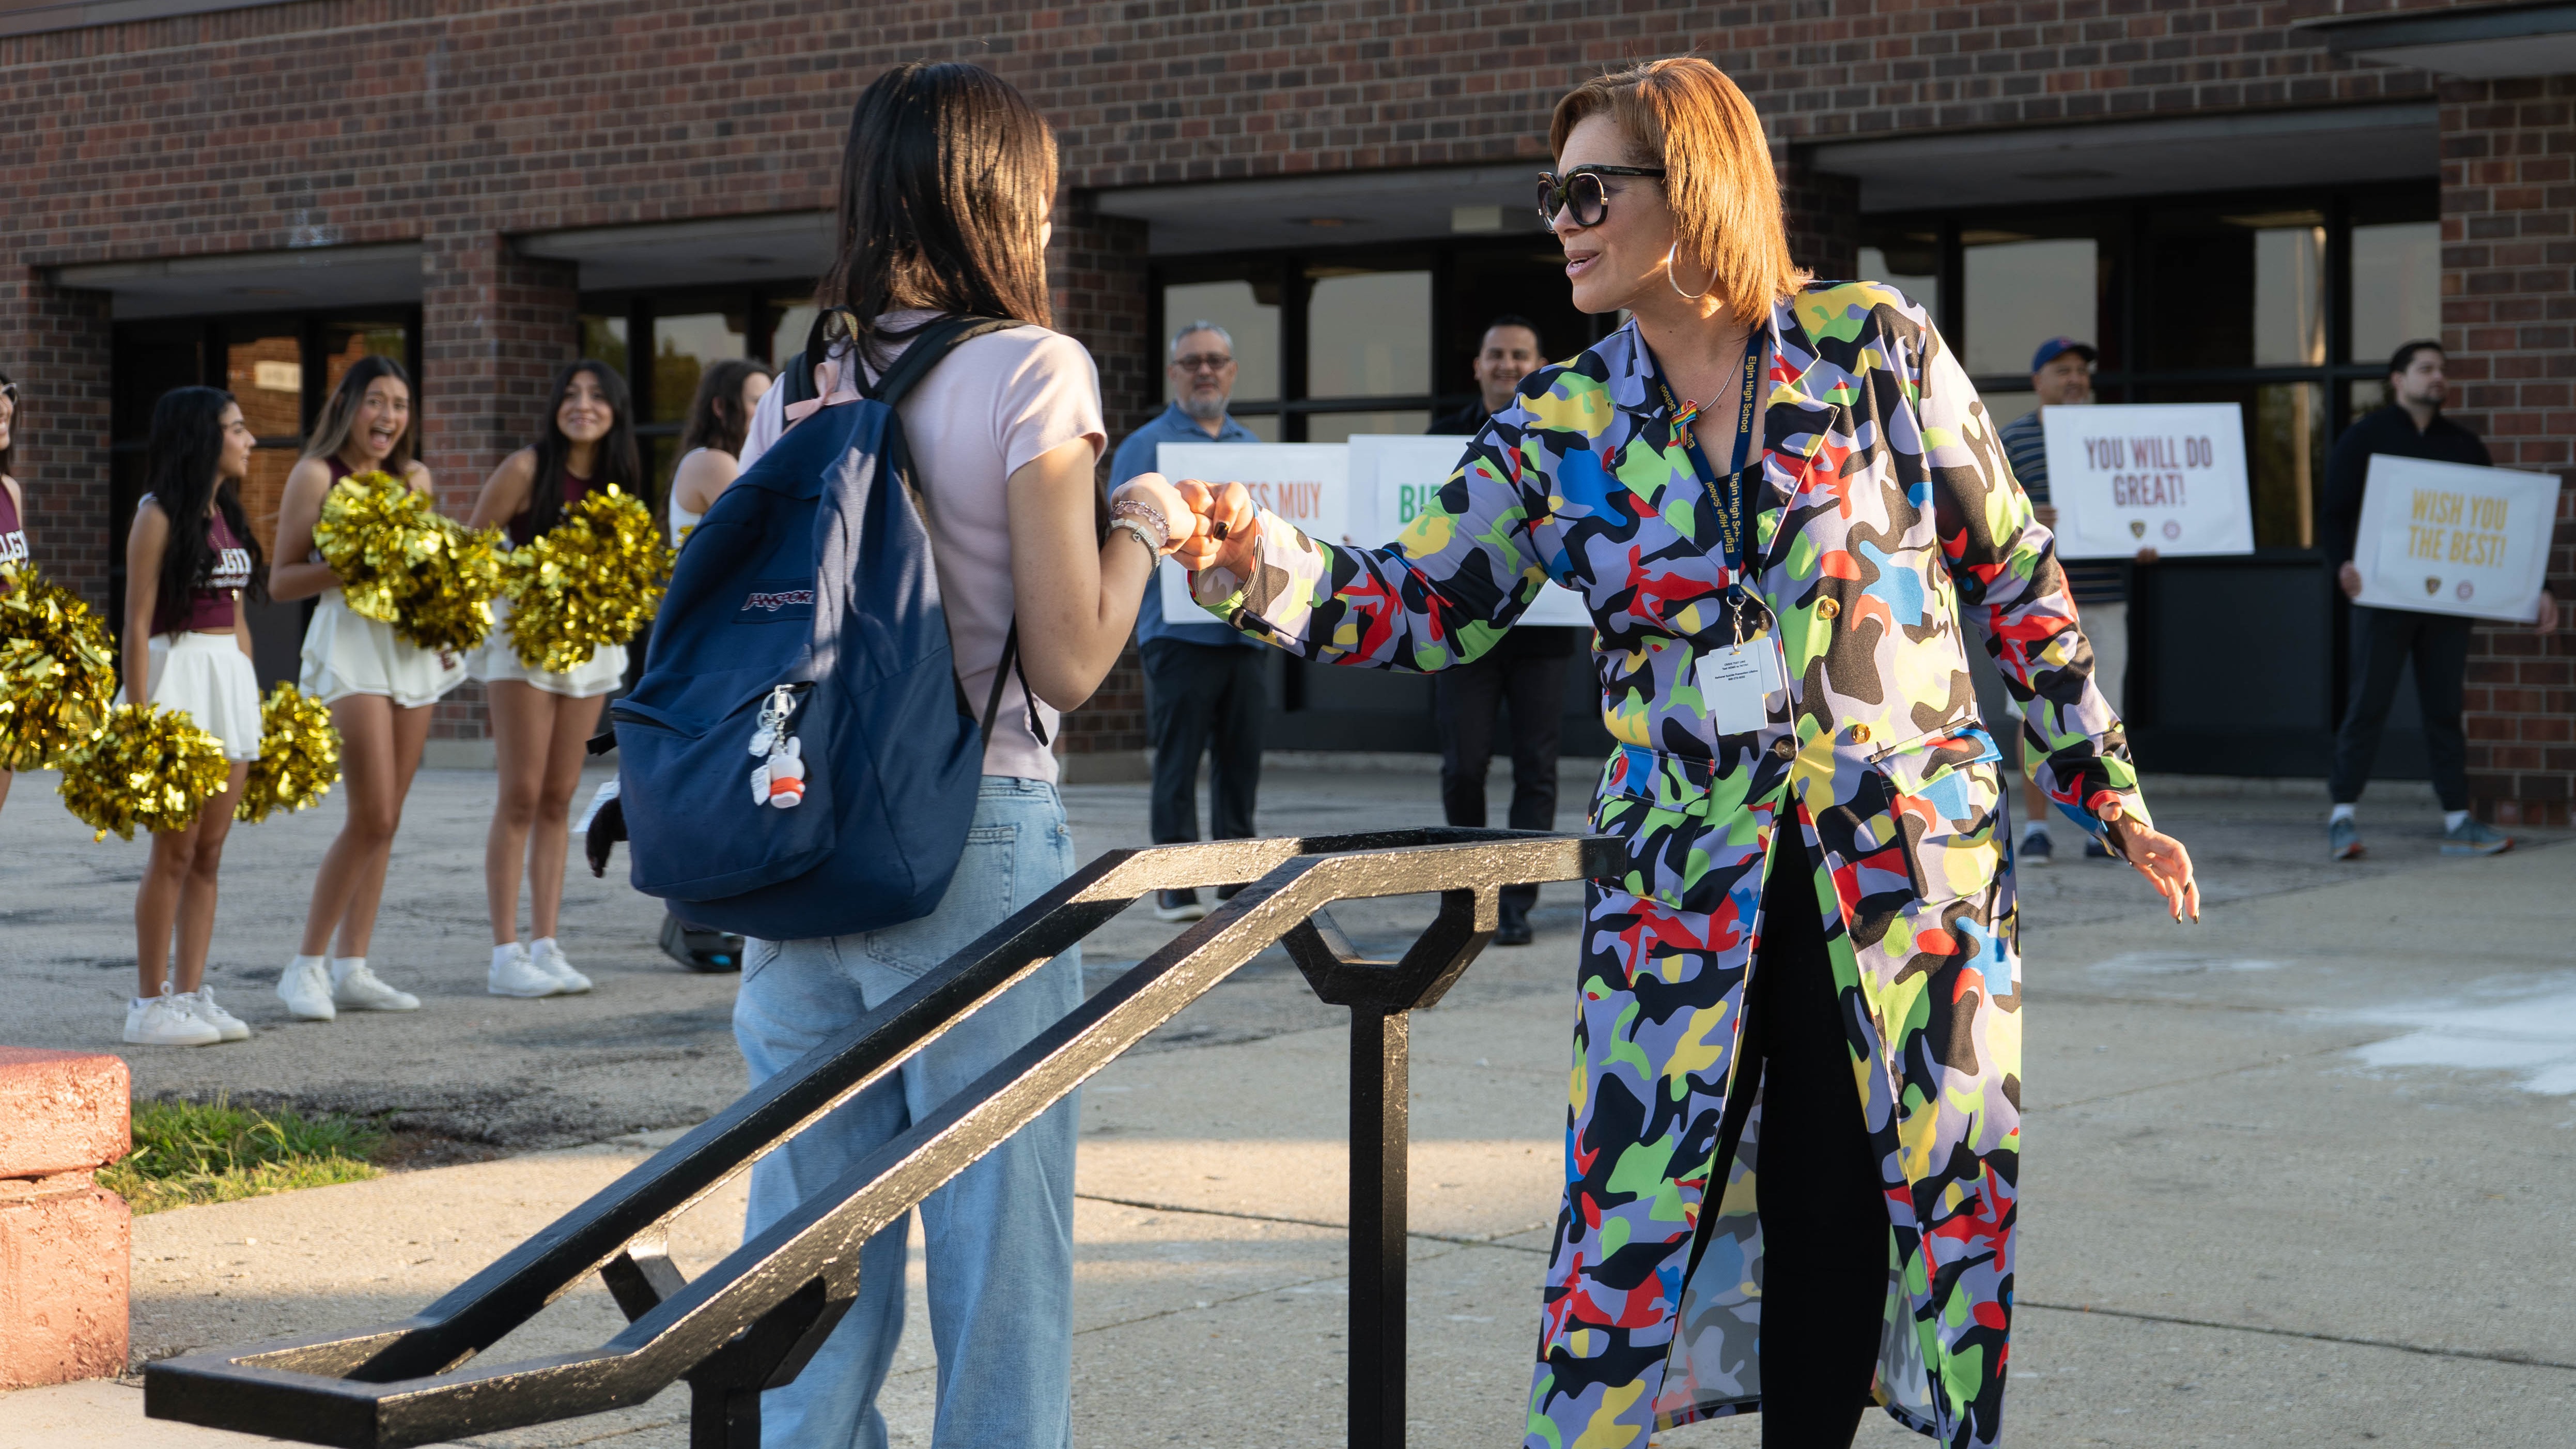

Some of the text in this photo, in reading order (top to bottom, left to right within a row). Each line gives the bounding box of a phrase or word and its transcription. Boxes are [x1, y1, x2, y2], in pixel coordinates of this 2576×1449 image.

[1659, 384, 1676, 411] School
[1740, 356, 1757, 433] Elgin High School
[1687, 433, 1696, 449] Elg
[2084, 436, 2213, 470] YOU WILL DO
[1277, 481, 1322, 520] MUY
[1730, 472, 1740, 496] Elgin
[2113, 473, 2186, 507] GREAT!
[1705, 482, 1735, 553] Elgin High School
[1730, 497, 1740, 519] High
[2412, 488, 2509, 531] WISH YOU
[2409, 525, 2508, 568] THE BEST!
[740, 590, 815, 611] JANSPOR
